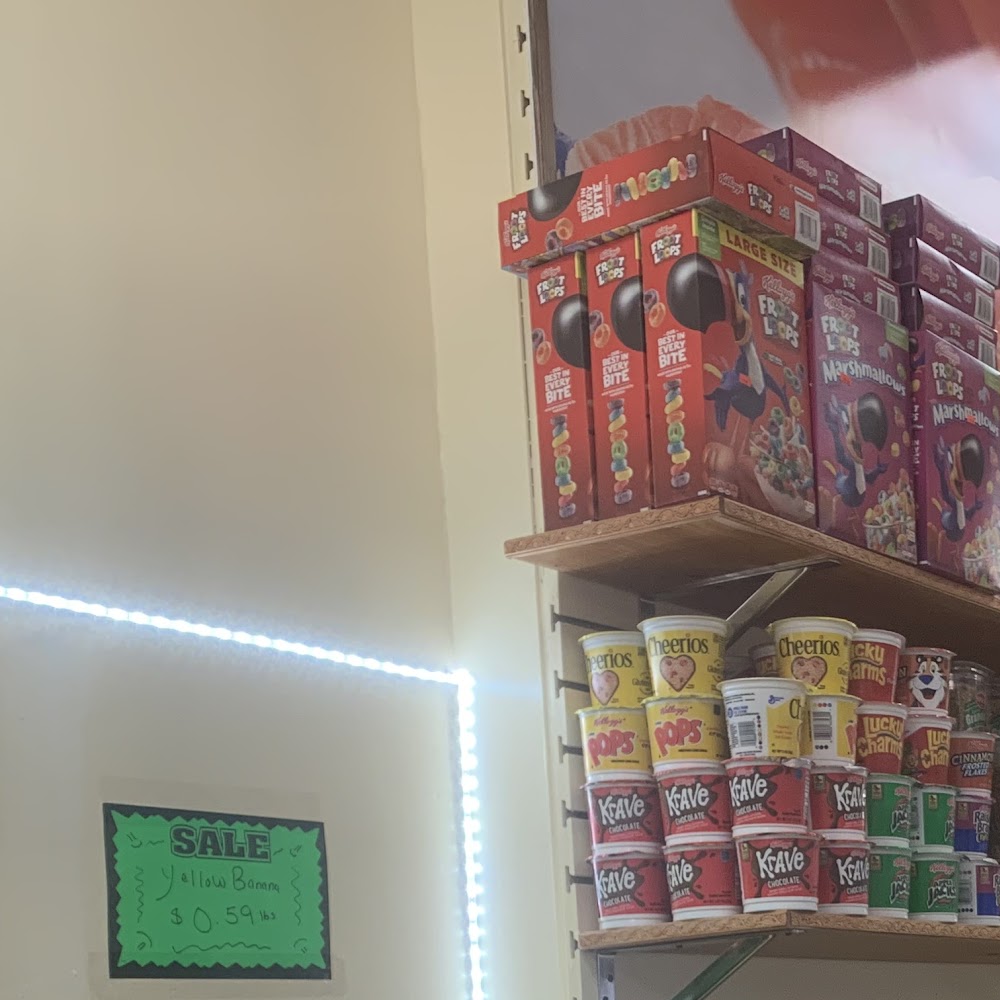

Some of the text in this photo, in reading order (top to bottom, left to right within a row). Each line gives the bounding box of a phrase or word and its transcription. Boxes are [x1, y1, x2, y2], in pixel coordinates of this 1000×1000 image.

[593, 181, 605, 219] BITE
[725, 230, 797, 279] LARGE SIZE
[658, 340, 686, 355] EVERY
[658, 348, 687, 369] BITE
[603, 368, 630, 388] BITE
[546, 385, 571, 404] BITE
[648, 633, 709, 656] Cheerios
[779, 635, 840, 658] Cheerios
[585, 649, 633, 673] heerios
[852, 666, 886, 687] arms
[675, 811, 705, 825] CHOCOLATE
[735, 803, 763, 816] CHOCOLATE
[609, 821, 640, 834] CHOCOLATE
[170, 824, 271, 863] SALE
[156, 865, 226, 901] Yellow
[768, 876, 800, 889] CHOCOLATE
